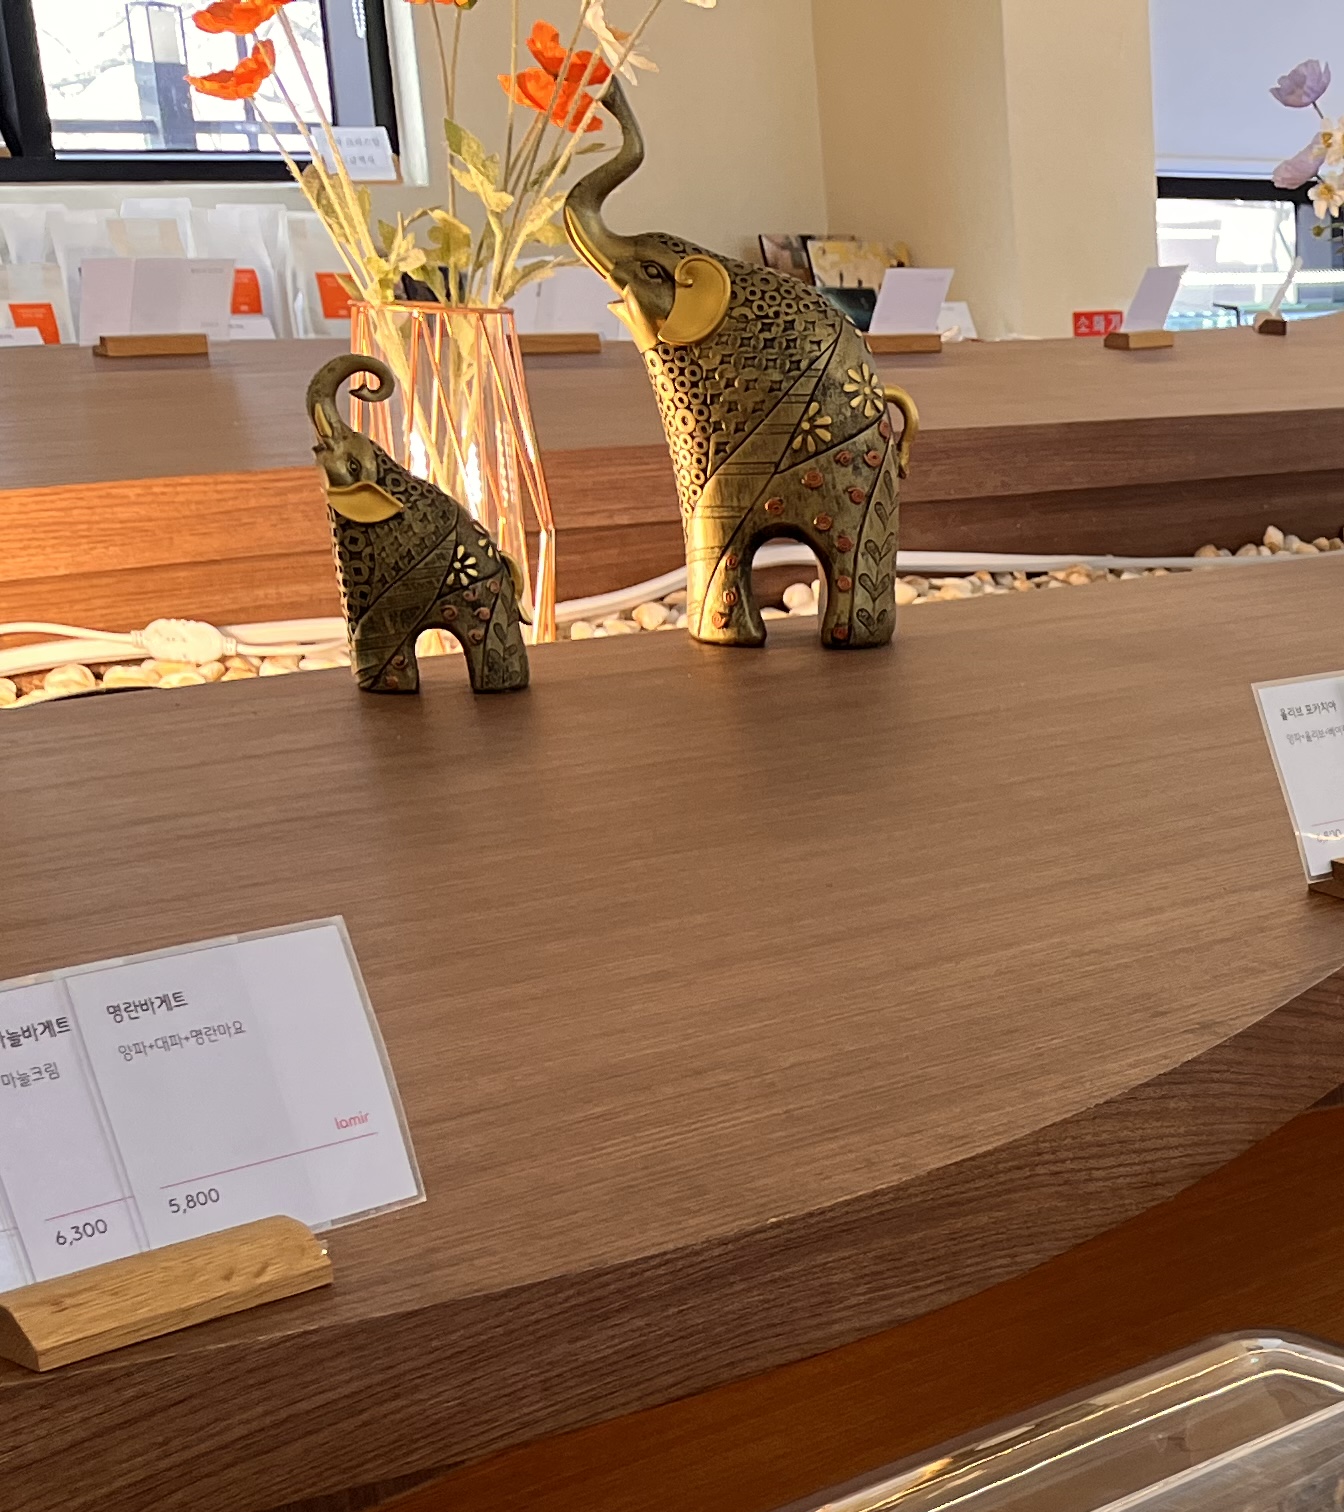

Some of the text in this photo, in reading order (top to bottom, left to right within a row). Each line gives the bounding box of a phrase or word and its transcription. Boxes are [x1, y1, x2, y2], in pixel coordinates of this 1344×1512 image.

[107, 990, 189, 1024] 명란바게트
[1, 1062, 60, 1088] 마늘크림
[169, 1188, 220, 1215] 5,800
[55, 1218, 108, 1247] 6,300
